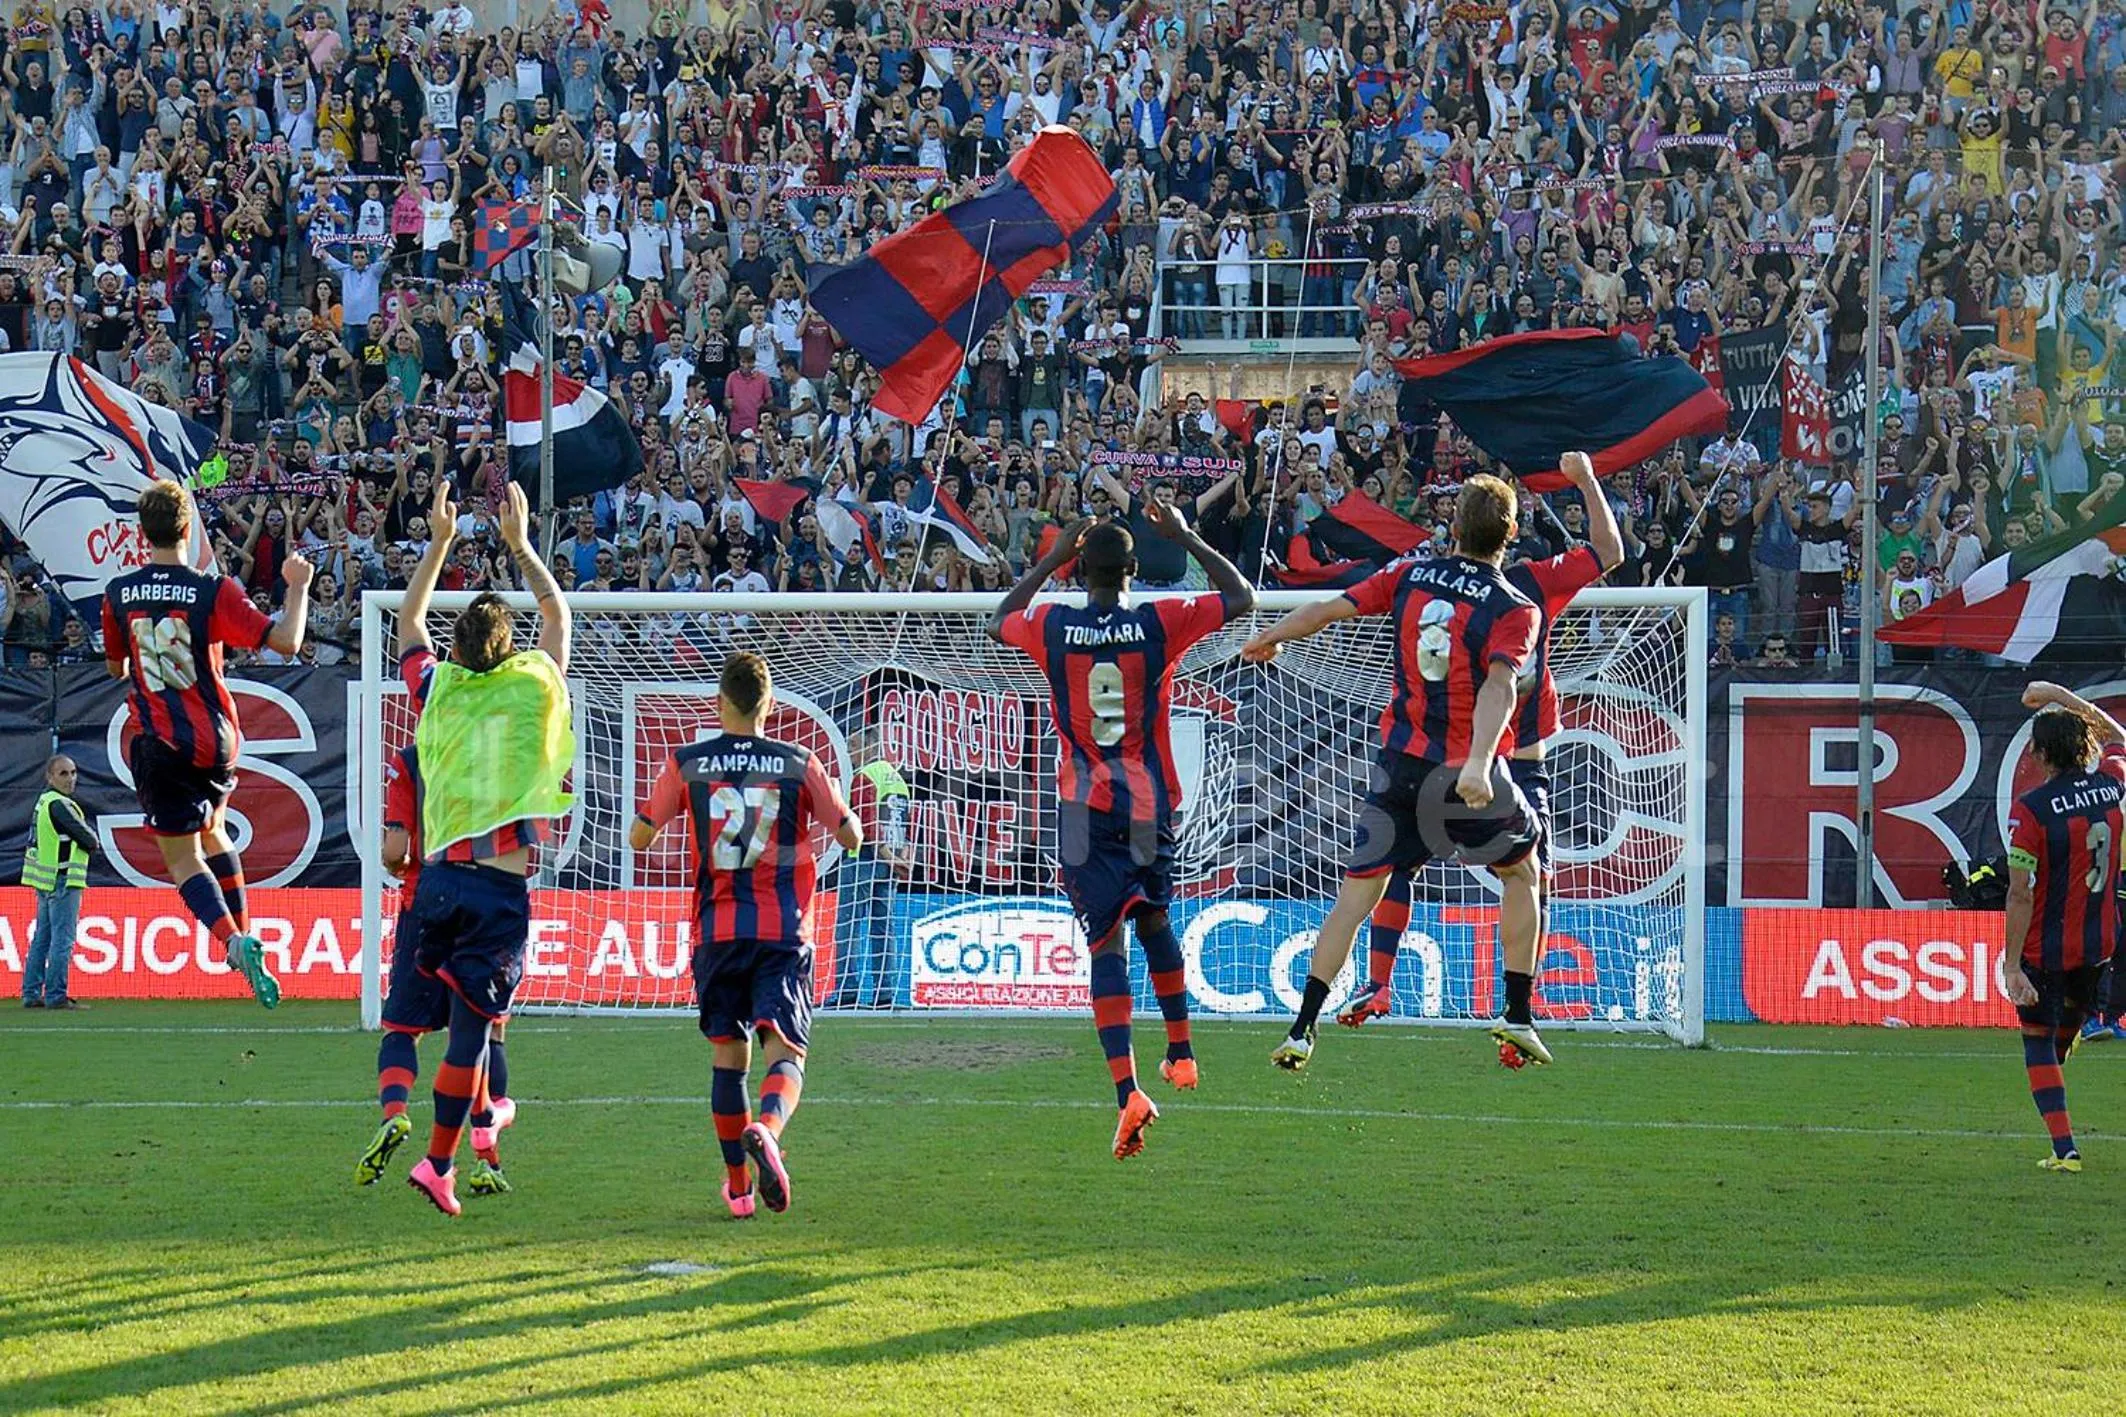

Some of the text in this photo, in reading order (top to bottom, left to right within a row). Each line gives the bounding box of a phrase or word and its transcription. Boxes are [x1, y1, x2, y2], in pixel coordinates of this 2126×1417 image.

[1722, 342, 1778, 370] TUTTA
[1737, 384, 1781, 411] VITA
[1093, 451, 1242, 470] CURVA SUD
[120, 584, 198, 604] BARBERIS
[1409, 567, 1493, 603] BALASA
[881, 687, 1025, 774] GIORGIO
[697, 754, 785, 774] ZAMPANO
[2050, 785, 2121, 814] CLAITON
[709, 787, 781, 870] 27
[2085, 821, 2112, 893] 3
[1801, 937, 2009, 1003] ASSI
